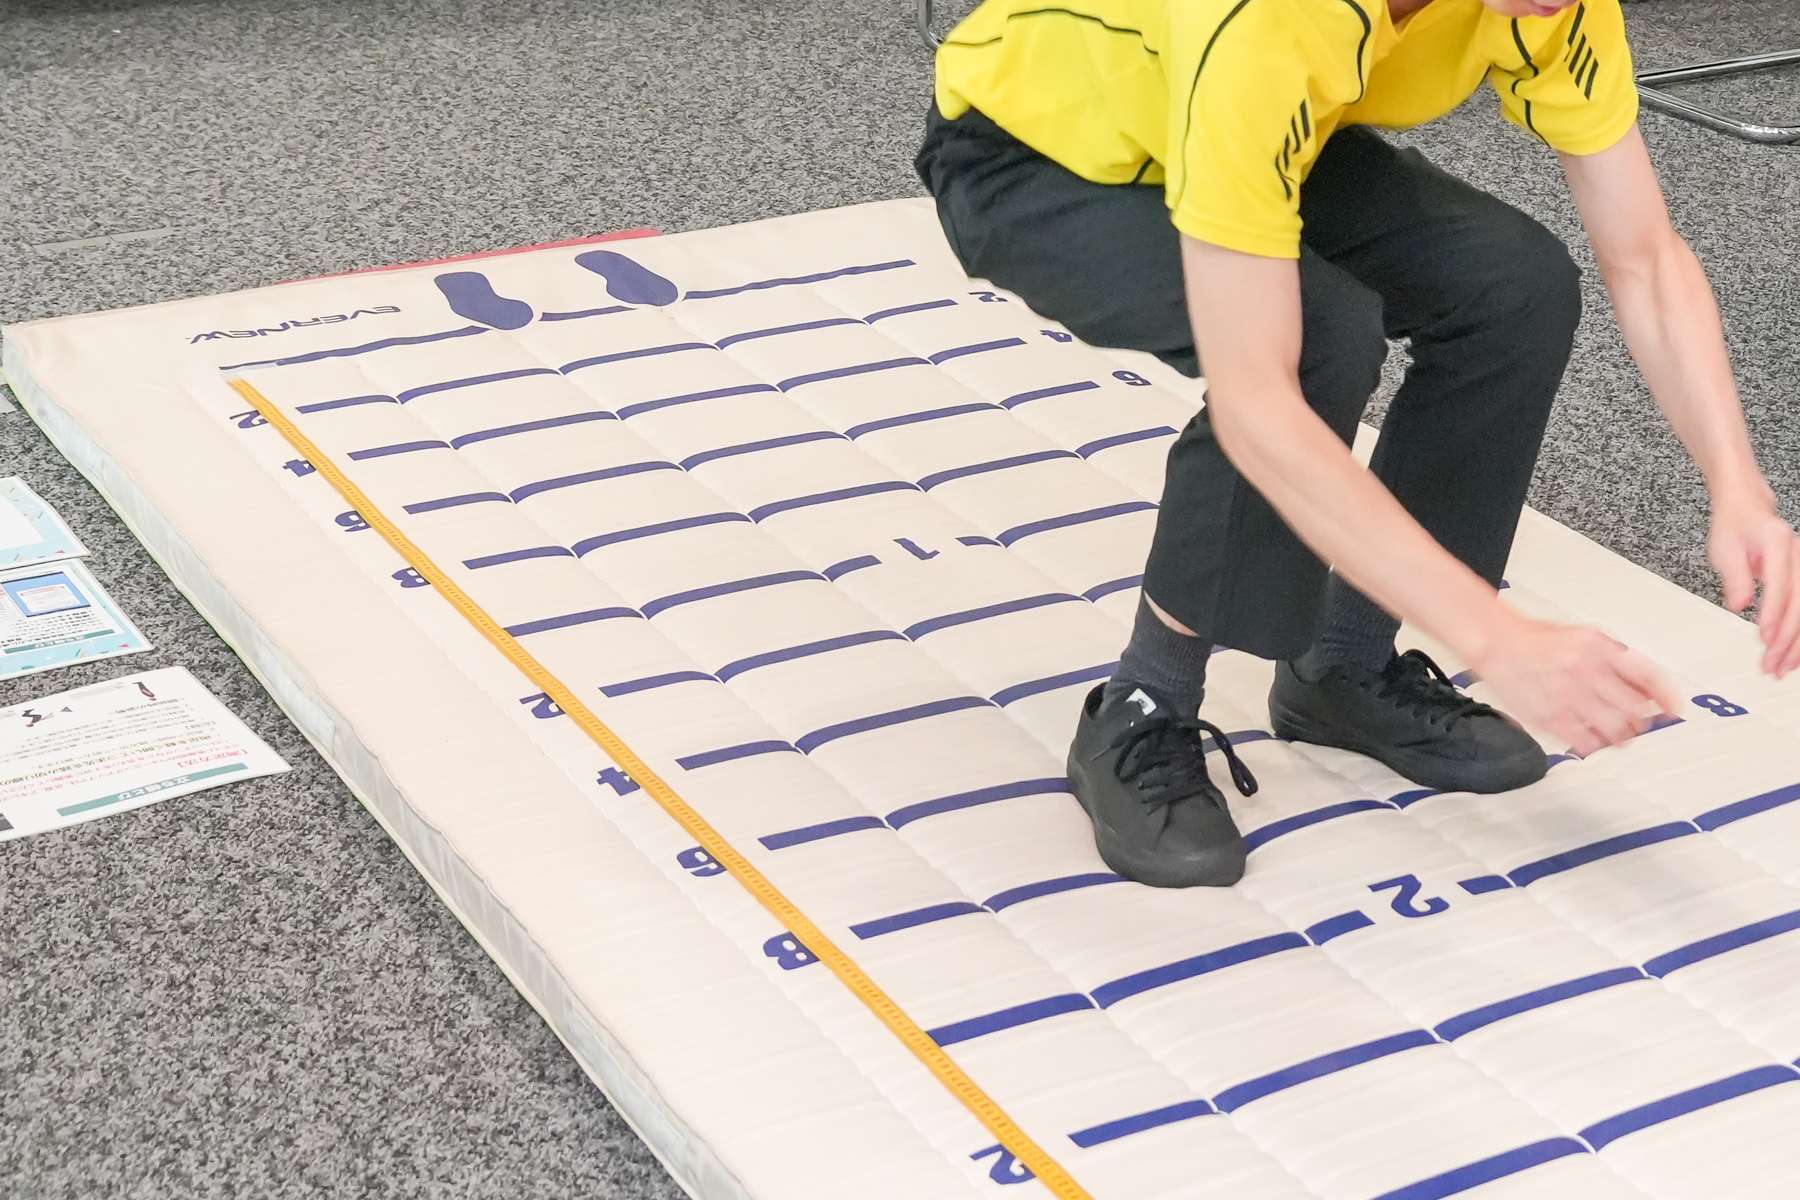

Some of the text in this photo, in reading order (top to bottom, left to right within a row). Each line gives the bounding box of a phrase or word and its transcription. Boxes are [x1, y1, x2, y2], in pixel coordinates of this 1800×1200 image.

[969, 291, 1007, 302] 2
[190, 305, 401, 344] EVERNEW
[1040, 329, 1073, 343] 4
[893, 537, 940, 561] 1
[519, 691, 566, 719] 2
[1691, 693, 1747, 718] 8
[1369, 874, 1449, 919] 2
[969, 1142, 1037, 1185] 2
